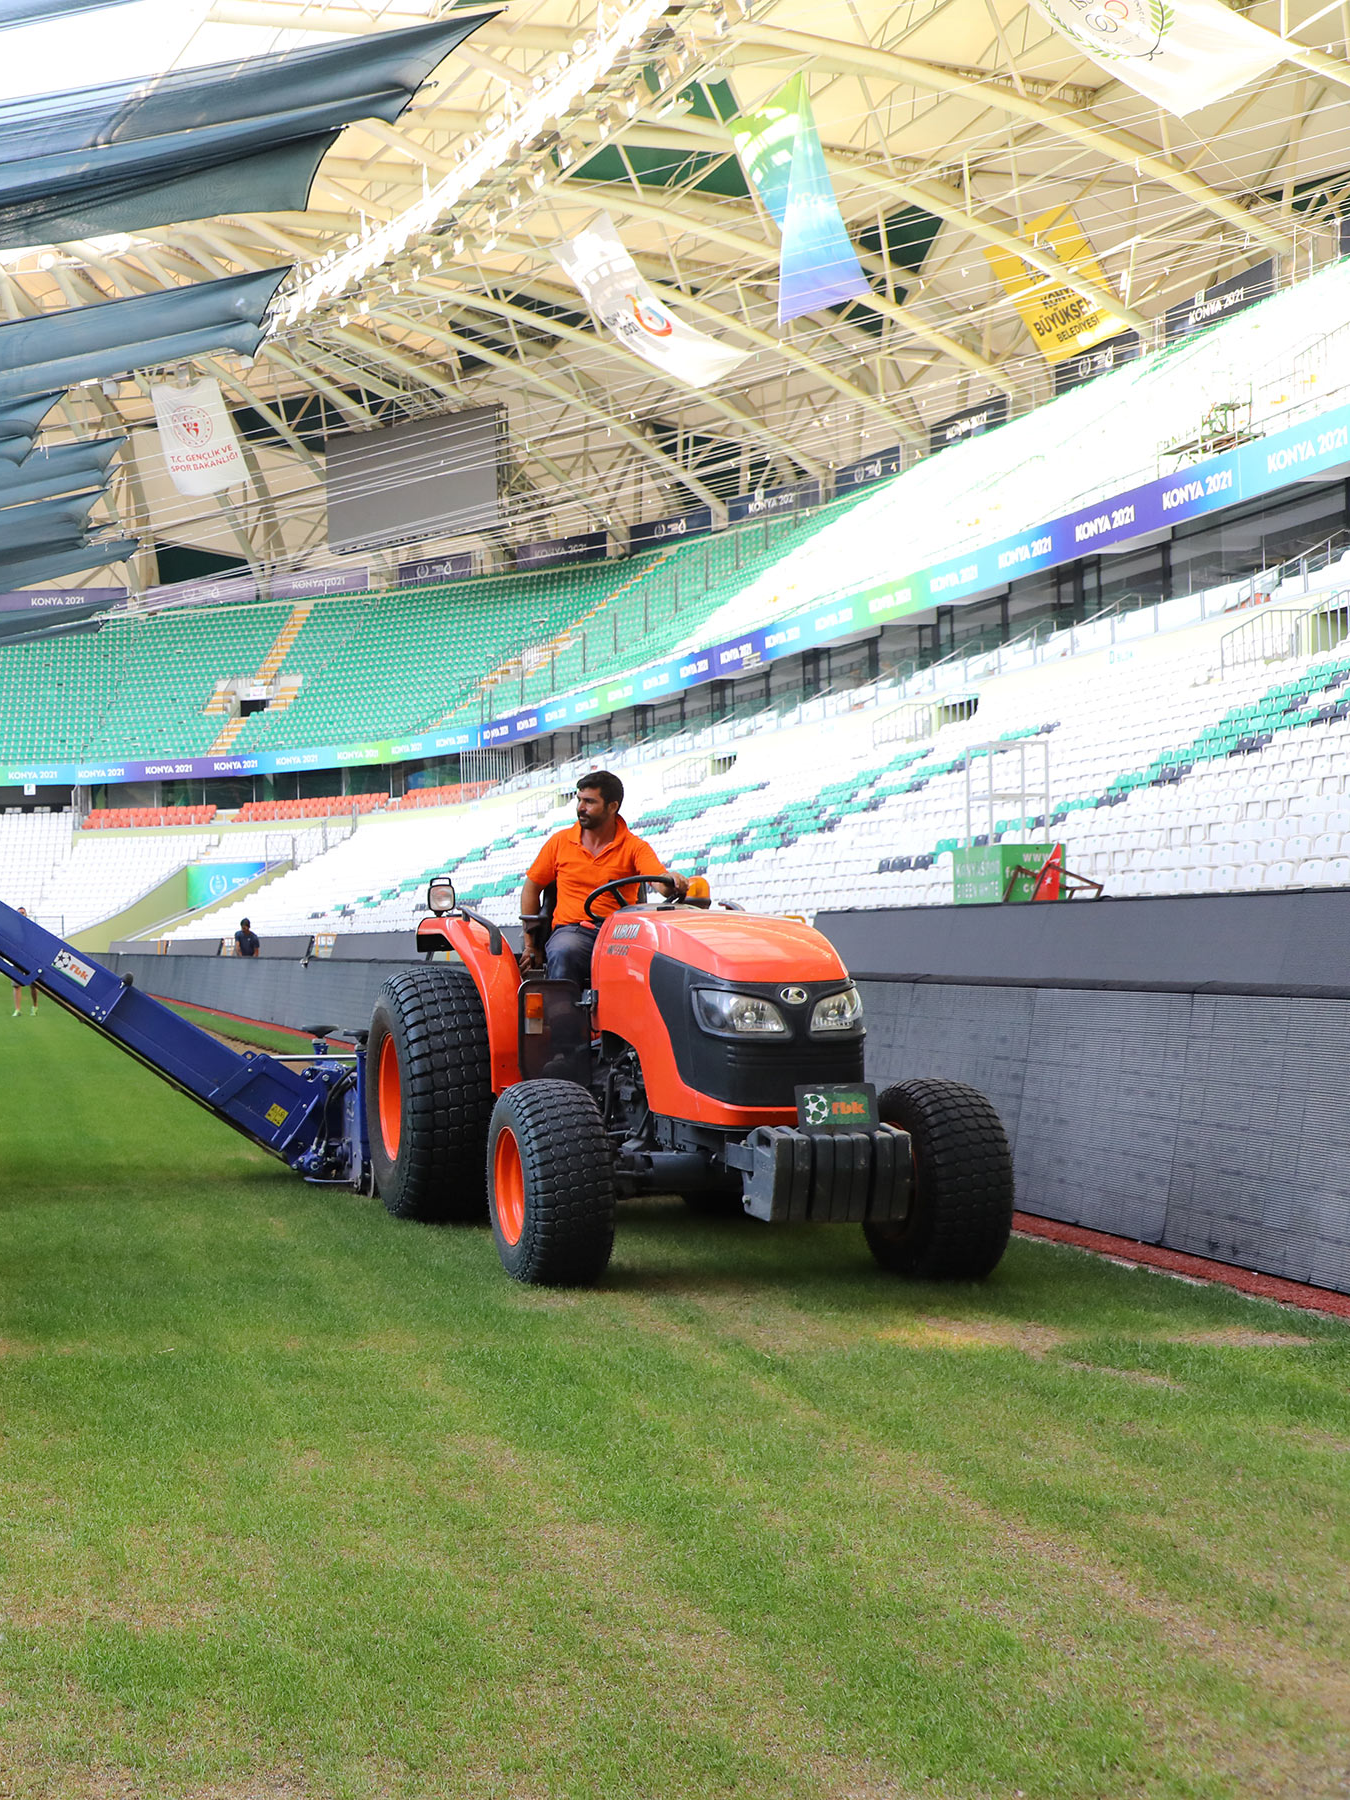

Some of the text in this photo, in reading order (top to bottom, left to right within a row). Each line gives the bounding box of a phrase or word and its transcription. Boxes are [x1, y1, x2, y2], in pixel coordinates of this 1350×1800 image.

[1056, 315, 1100, 343] BELEDİYESİ
[170, 444, 233, 463] T.C. GENÇLİK VE
[1267, 425, 1349, 474] KONYA 2021
[170, 452, 239, 472] SPOR BAKANLIĞI
[1162, 469, 1233, 511] KONYA 2021
[1075, 505, 1135, 542] KONYA 2021
[998, 536, 1052, 569] KONYA 2021
[930, 565, 978, 593] KONYA 2021
[31, 597, 84, 606] KONYA 2021
[391, 742, 423, 755] KONYA 2021
[436, 735, 469, 748] KONYA 2021
[276, 755, 318, 766] KONYA 2021
[337, 750, 379, 760] KONYA 2021
[145, 765, 193, 775] KONYA 2021
[214, 759, 258, 771] KONYA 2021
[8, 771, 58, 780] KONYA 2021
[78, 768, 125, 778] KONYA 2021
[611, 924, 641, 939] KUBOTA
[832, 1101, 866, 1115] fbk
